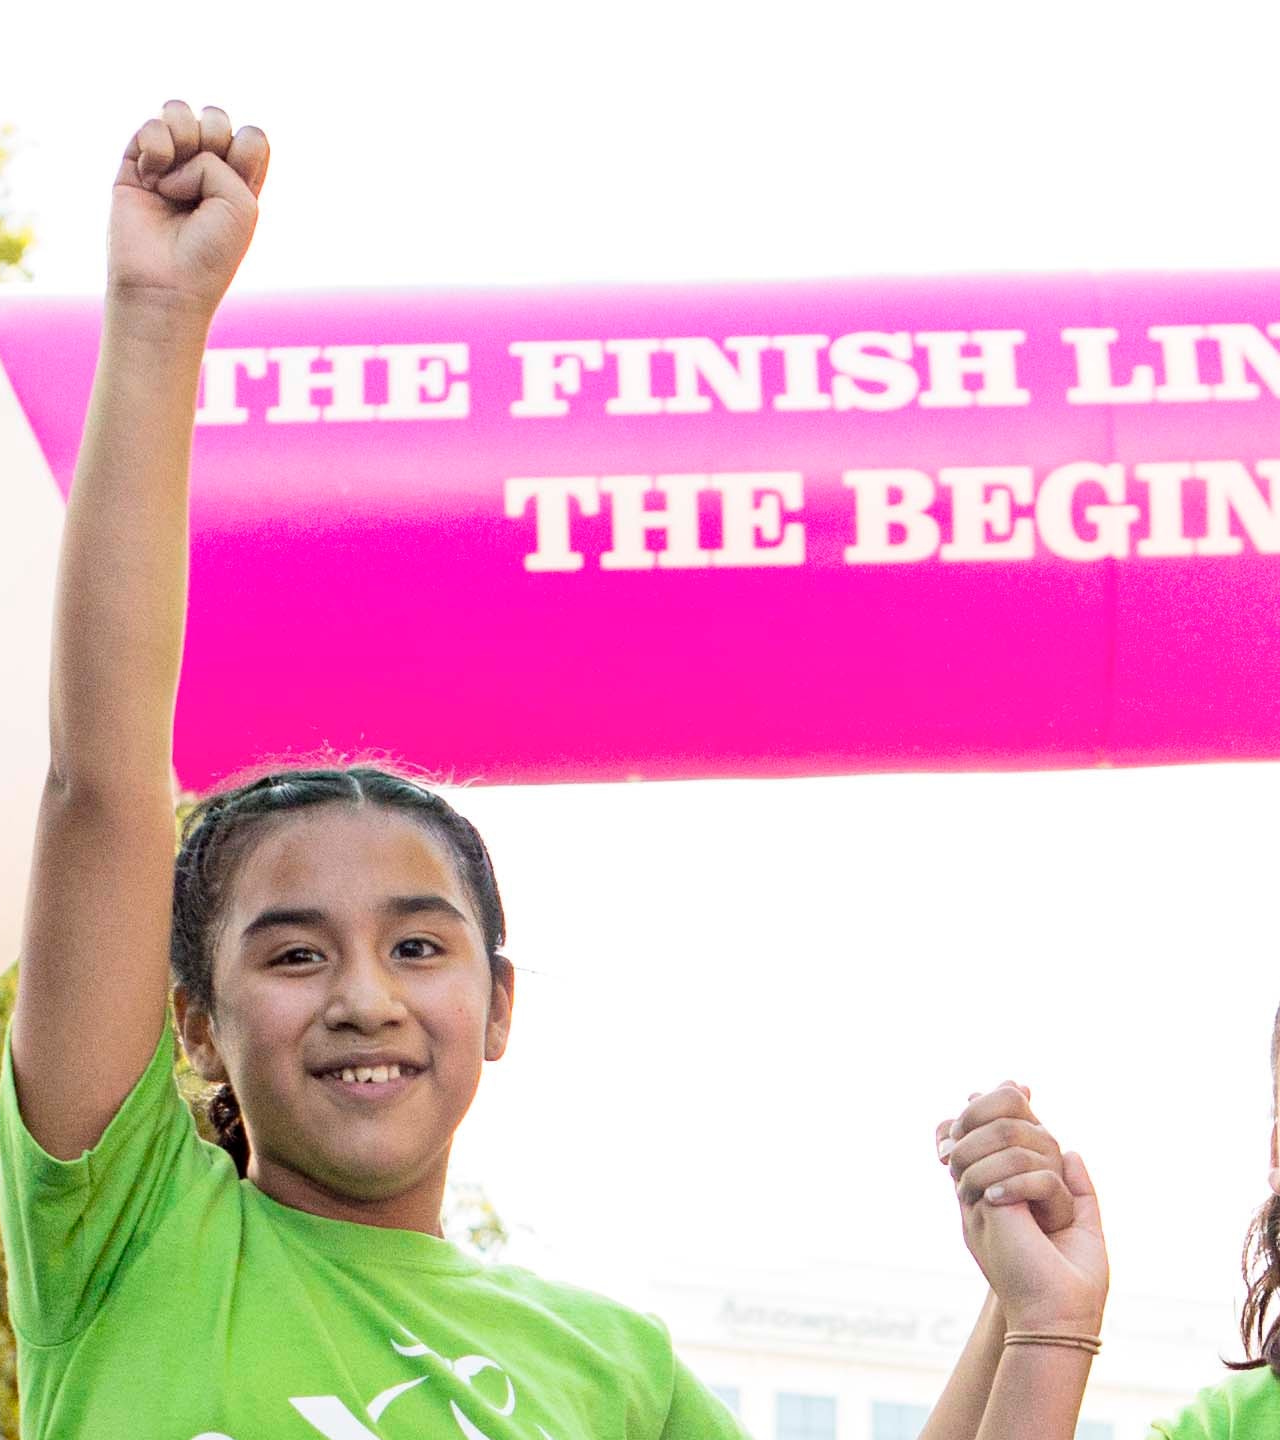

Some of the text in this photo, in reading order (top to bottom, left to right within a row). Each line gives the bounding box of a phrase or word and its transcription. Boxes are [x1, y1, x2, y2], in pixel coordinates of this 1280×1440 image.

[195, 343, 471, 426] THE
[509, 329, 1030, 419] FINISH
[505, 471, 806, 574] THE
